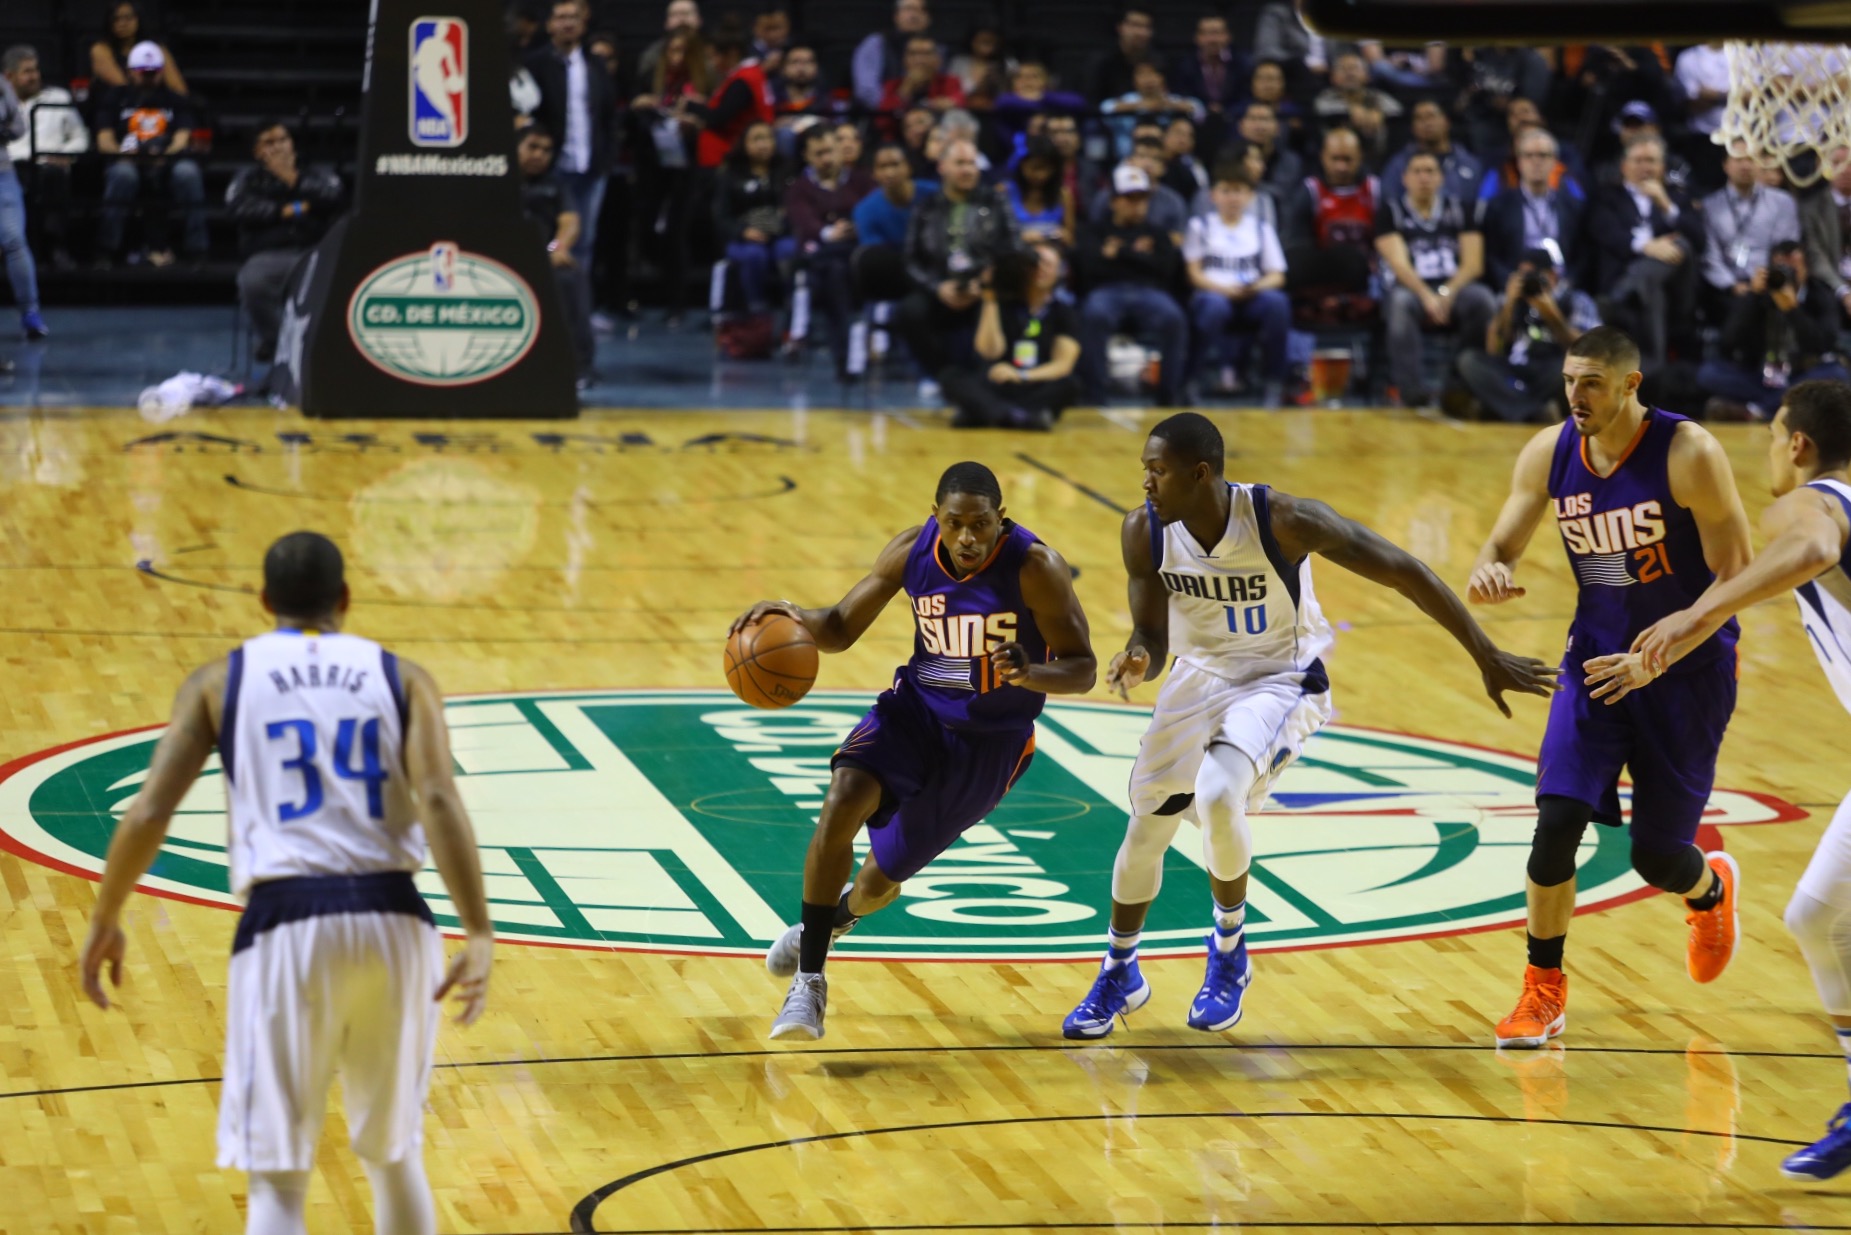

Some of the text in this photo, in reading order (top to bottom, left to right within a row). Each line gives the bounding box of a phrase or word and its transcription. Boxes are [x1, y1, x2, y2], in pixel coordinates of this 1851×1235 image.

[417, 118, 450, 136] NBA
[376, 155, 508, 176] #NBAMexico25
[366, 301, 521, 326] CD. DE MÉXICO
[1553, 492, 1592, 518] LOS
[1634, 542, 1674, 584] 21
[1162, 571, 1267, 602] DALLAS
[911, 594, 946, 617] LOS
[1223, 603, 1268, 635] 10
[269, 664, 368, 694] HARRIS
[266, 717, 389, 823] 34
